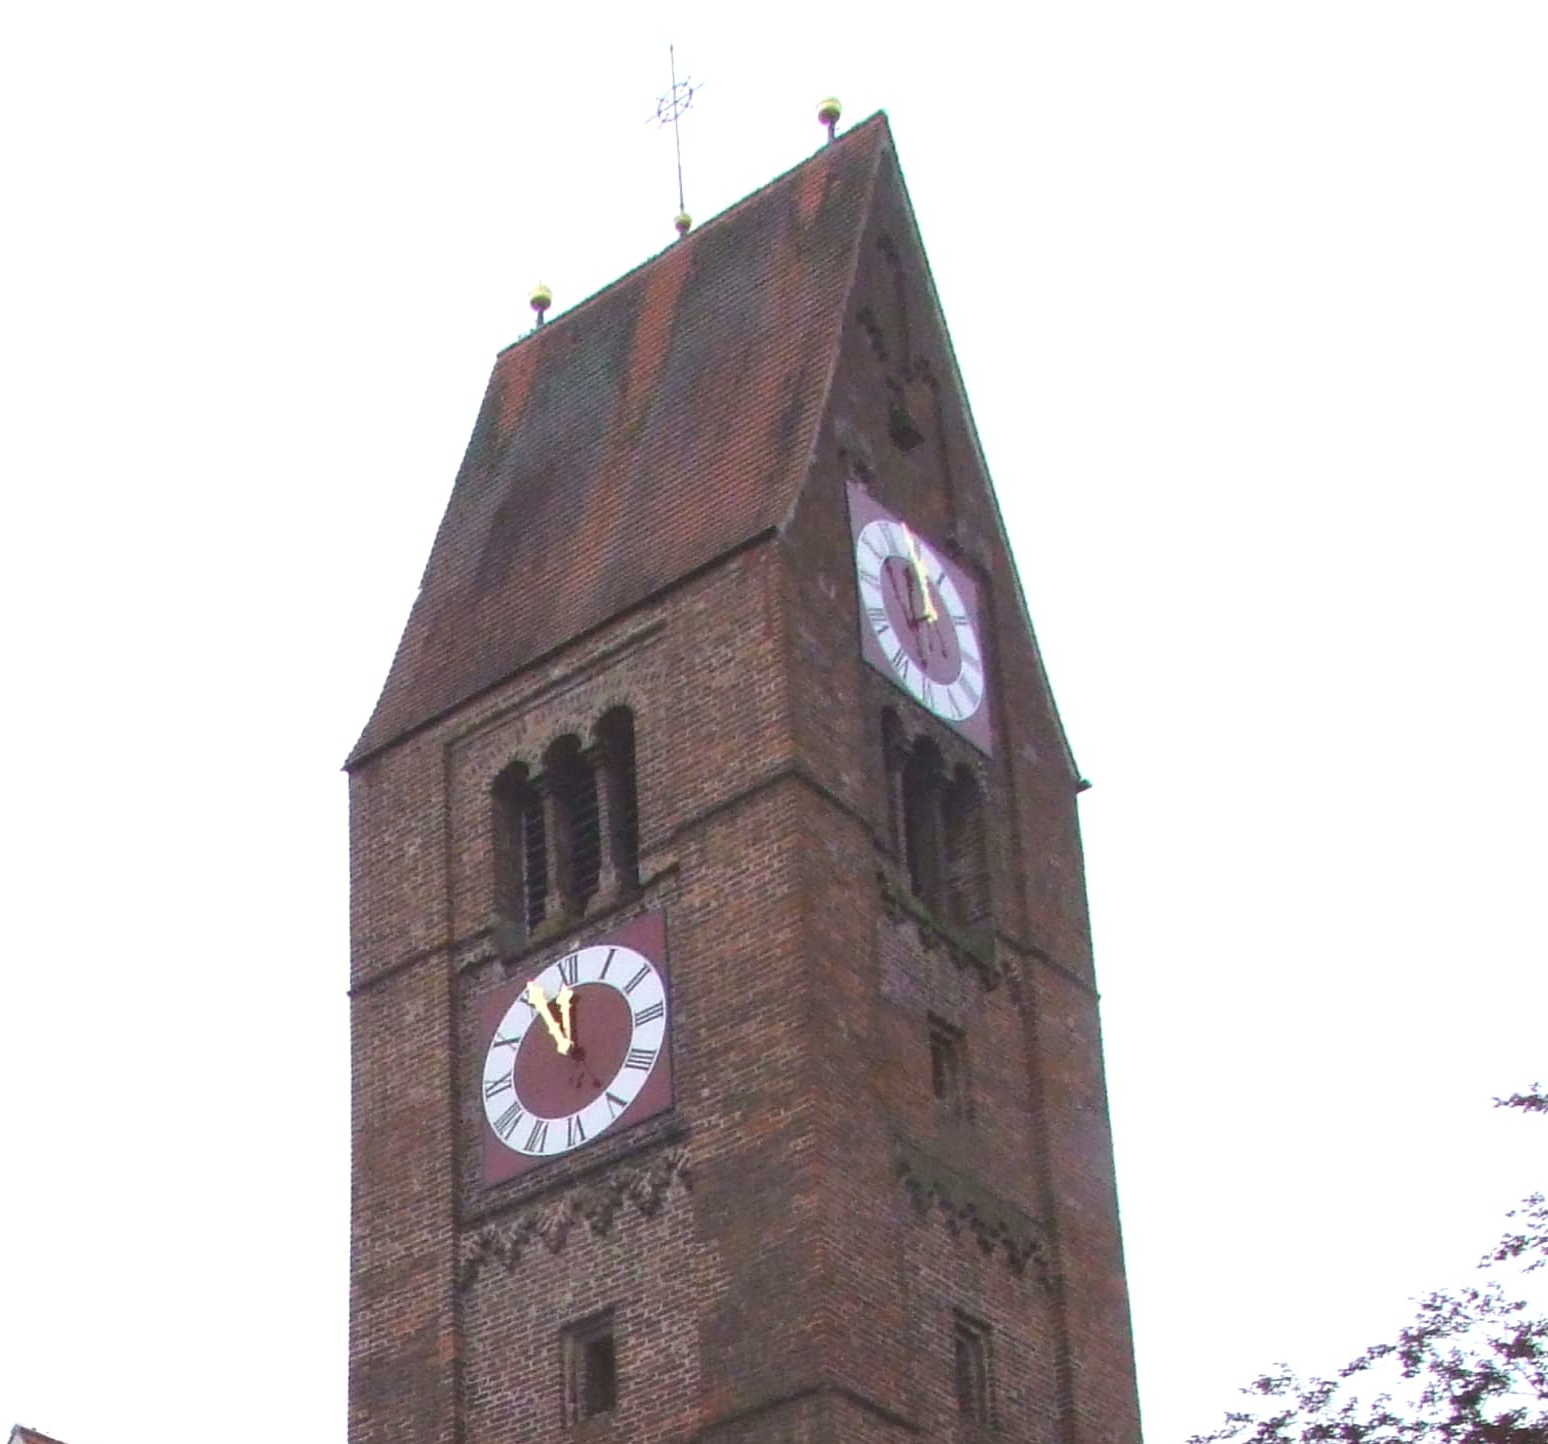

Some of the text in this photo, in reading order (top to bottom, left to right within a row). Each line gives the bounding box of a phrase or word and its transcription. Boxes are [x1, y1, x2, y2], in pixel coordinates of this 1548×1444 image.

[599, 948, 616, 980] I
[623, 962, 652, 995] II
[635, 999, 665, 1028] III
[492, 1033, 521, 1051] X
[606, 1091, 628, 1119] V
[567, 1114, 586, 1148] VI
